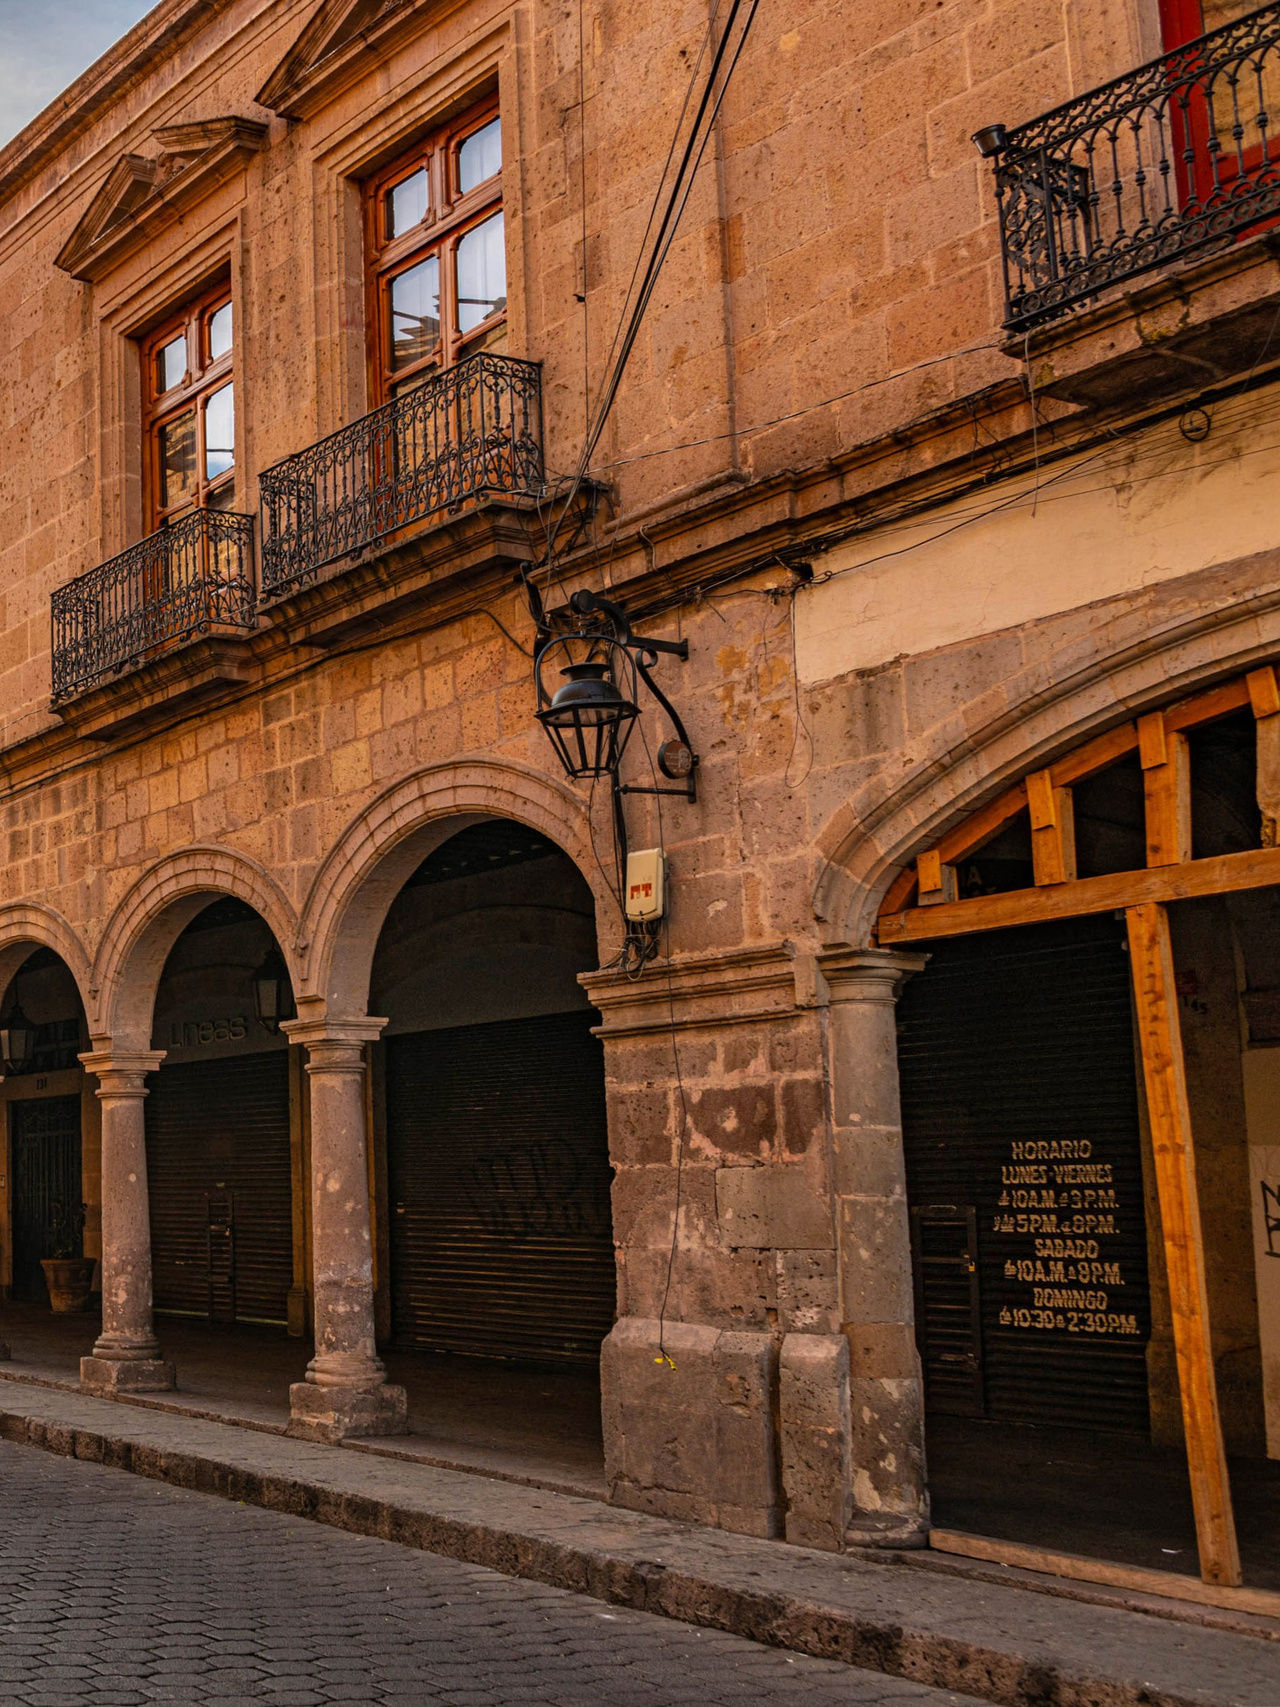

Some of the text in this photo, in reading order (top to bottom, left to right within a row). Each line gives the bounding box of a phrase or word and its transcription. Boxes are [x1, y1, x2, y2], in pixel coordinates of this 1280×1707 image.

[1011, 1139, 1093, 1160] HORARIO
[1034, 1238, 1100, 1259] SABADO
[1033, 1287, 1108, 1310] DOMINGO
